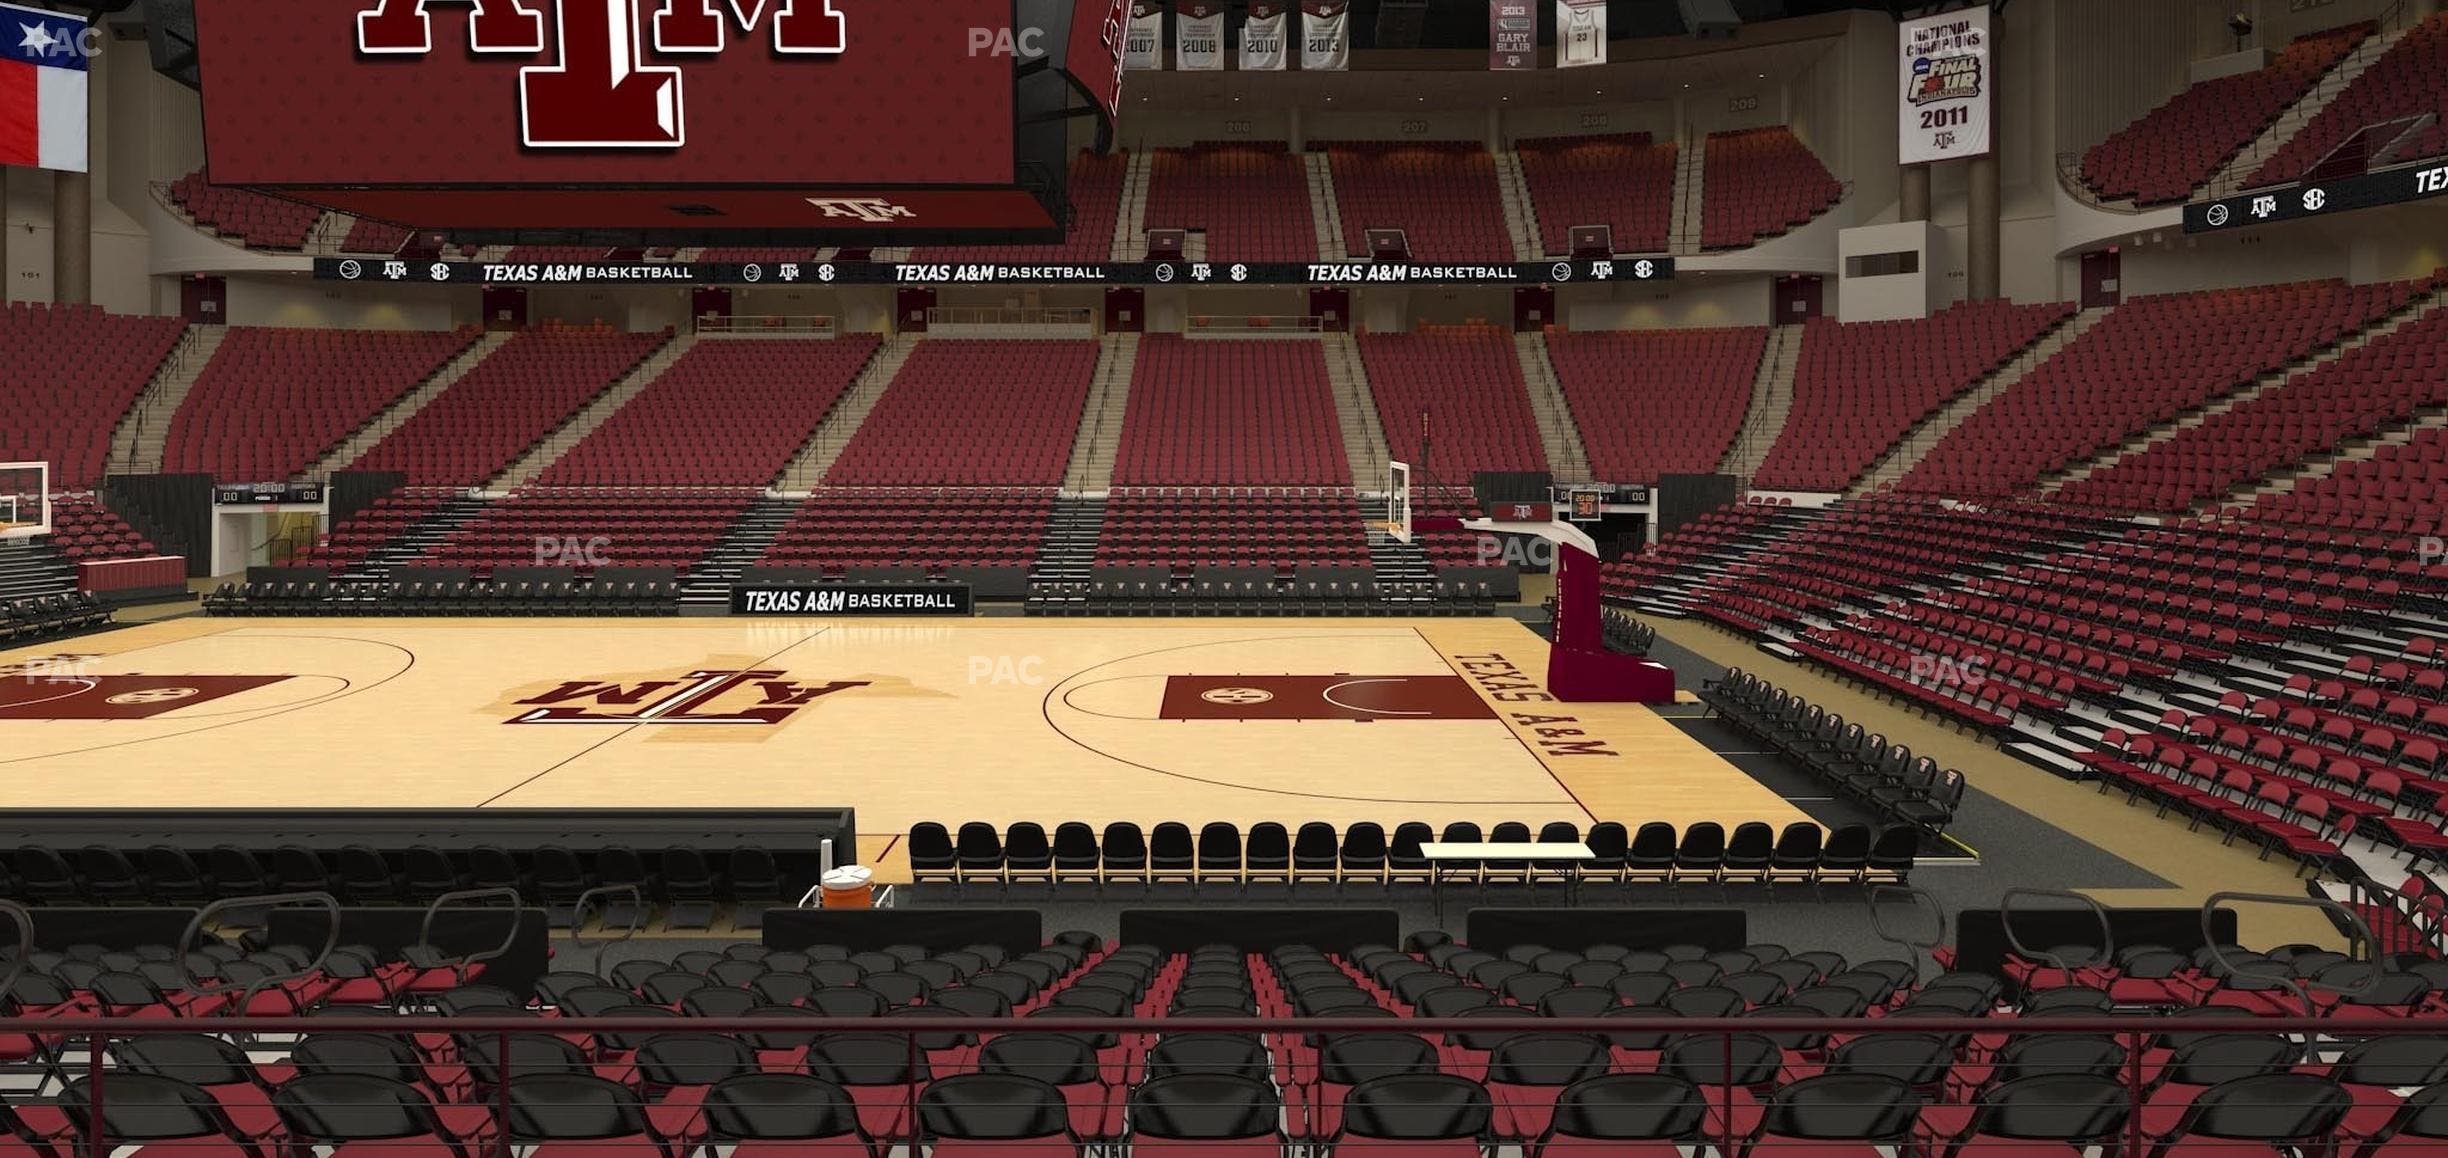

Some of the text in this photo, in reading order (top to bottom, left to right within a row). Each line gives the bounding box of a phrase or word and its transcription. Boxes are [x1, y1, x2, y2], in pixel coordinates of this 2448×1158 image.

[1501, 6, 1526, 15] 2013
[1498, 33, 1528, 42] GARY
[1914, 21, 1969, 42] NATIONAL
[1125, 40, 1154, 52] 007
[1247, 40, 1278, 52] 2010
[1309, 40, 1340, 52] 2013
[1496, 43, 1531, 52] BLAIR
[1906, 33, 1980, 56] CHAMPIONS
[1929, 56, 1977, 77] FINAL
[1920, 106, 1968, 129] 2011
[2302, 188, 2326, 210] SEC
[430, 263, 450, 281] SEC
[484, 264, 693, 281] TEXAS A&M BASKETBALL
[818, 264, 835, 281] SEC
[896, 264, 1105, 281] TEXAS A&M BASKETBALL
[1230, 264, 1247, 281] SEC
[1308, 264, 1517, 281] TEXAS A&M BASKETBALL
[1634, 260, 1653, 278] SEC
[223, 492, 237, 501] 00
[303, 491, 317, 500] 00
[1632, 492, 1645, 501] 00
[746, 590, 956, 612] TEXAS A&M BASKETBALL
[1454, 653, 1620, 756] TEXAS A&M
